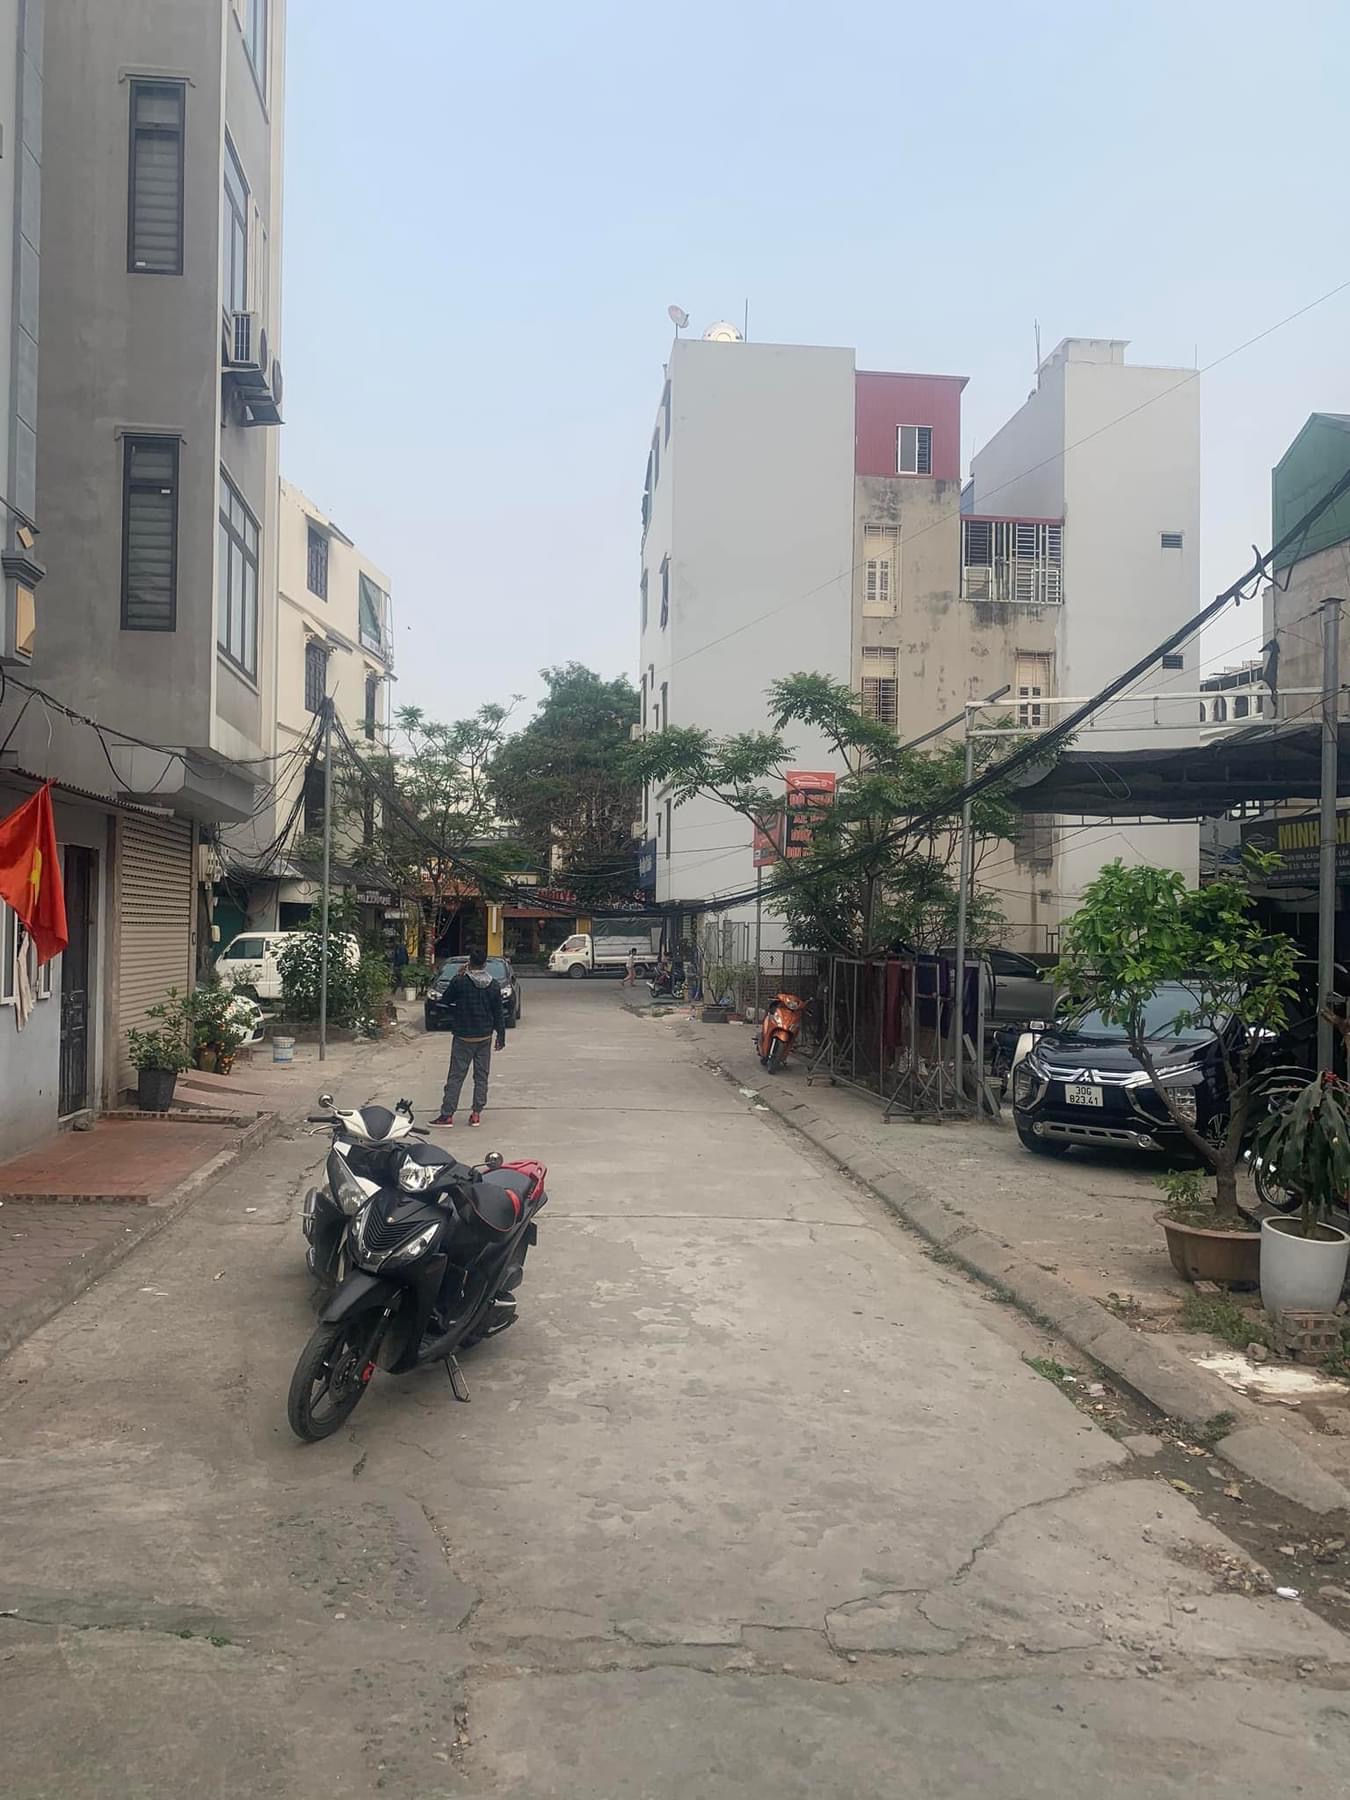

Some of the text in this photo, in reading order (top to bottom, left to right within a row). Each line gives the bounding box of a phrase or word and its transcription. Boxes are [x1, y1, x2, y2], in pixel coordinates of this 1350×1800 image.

[1279, 821, 1319, 849] MINH
[1075, 1086, 1092, 1095] 30G
[1069, 1095, 1098, 1104] 823.41
